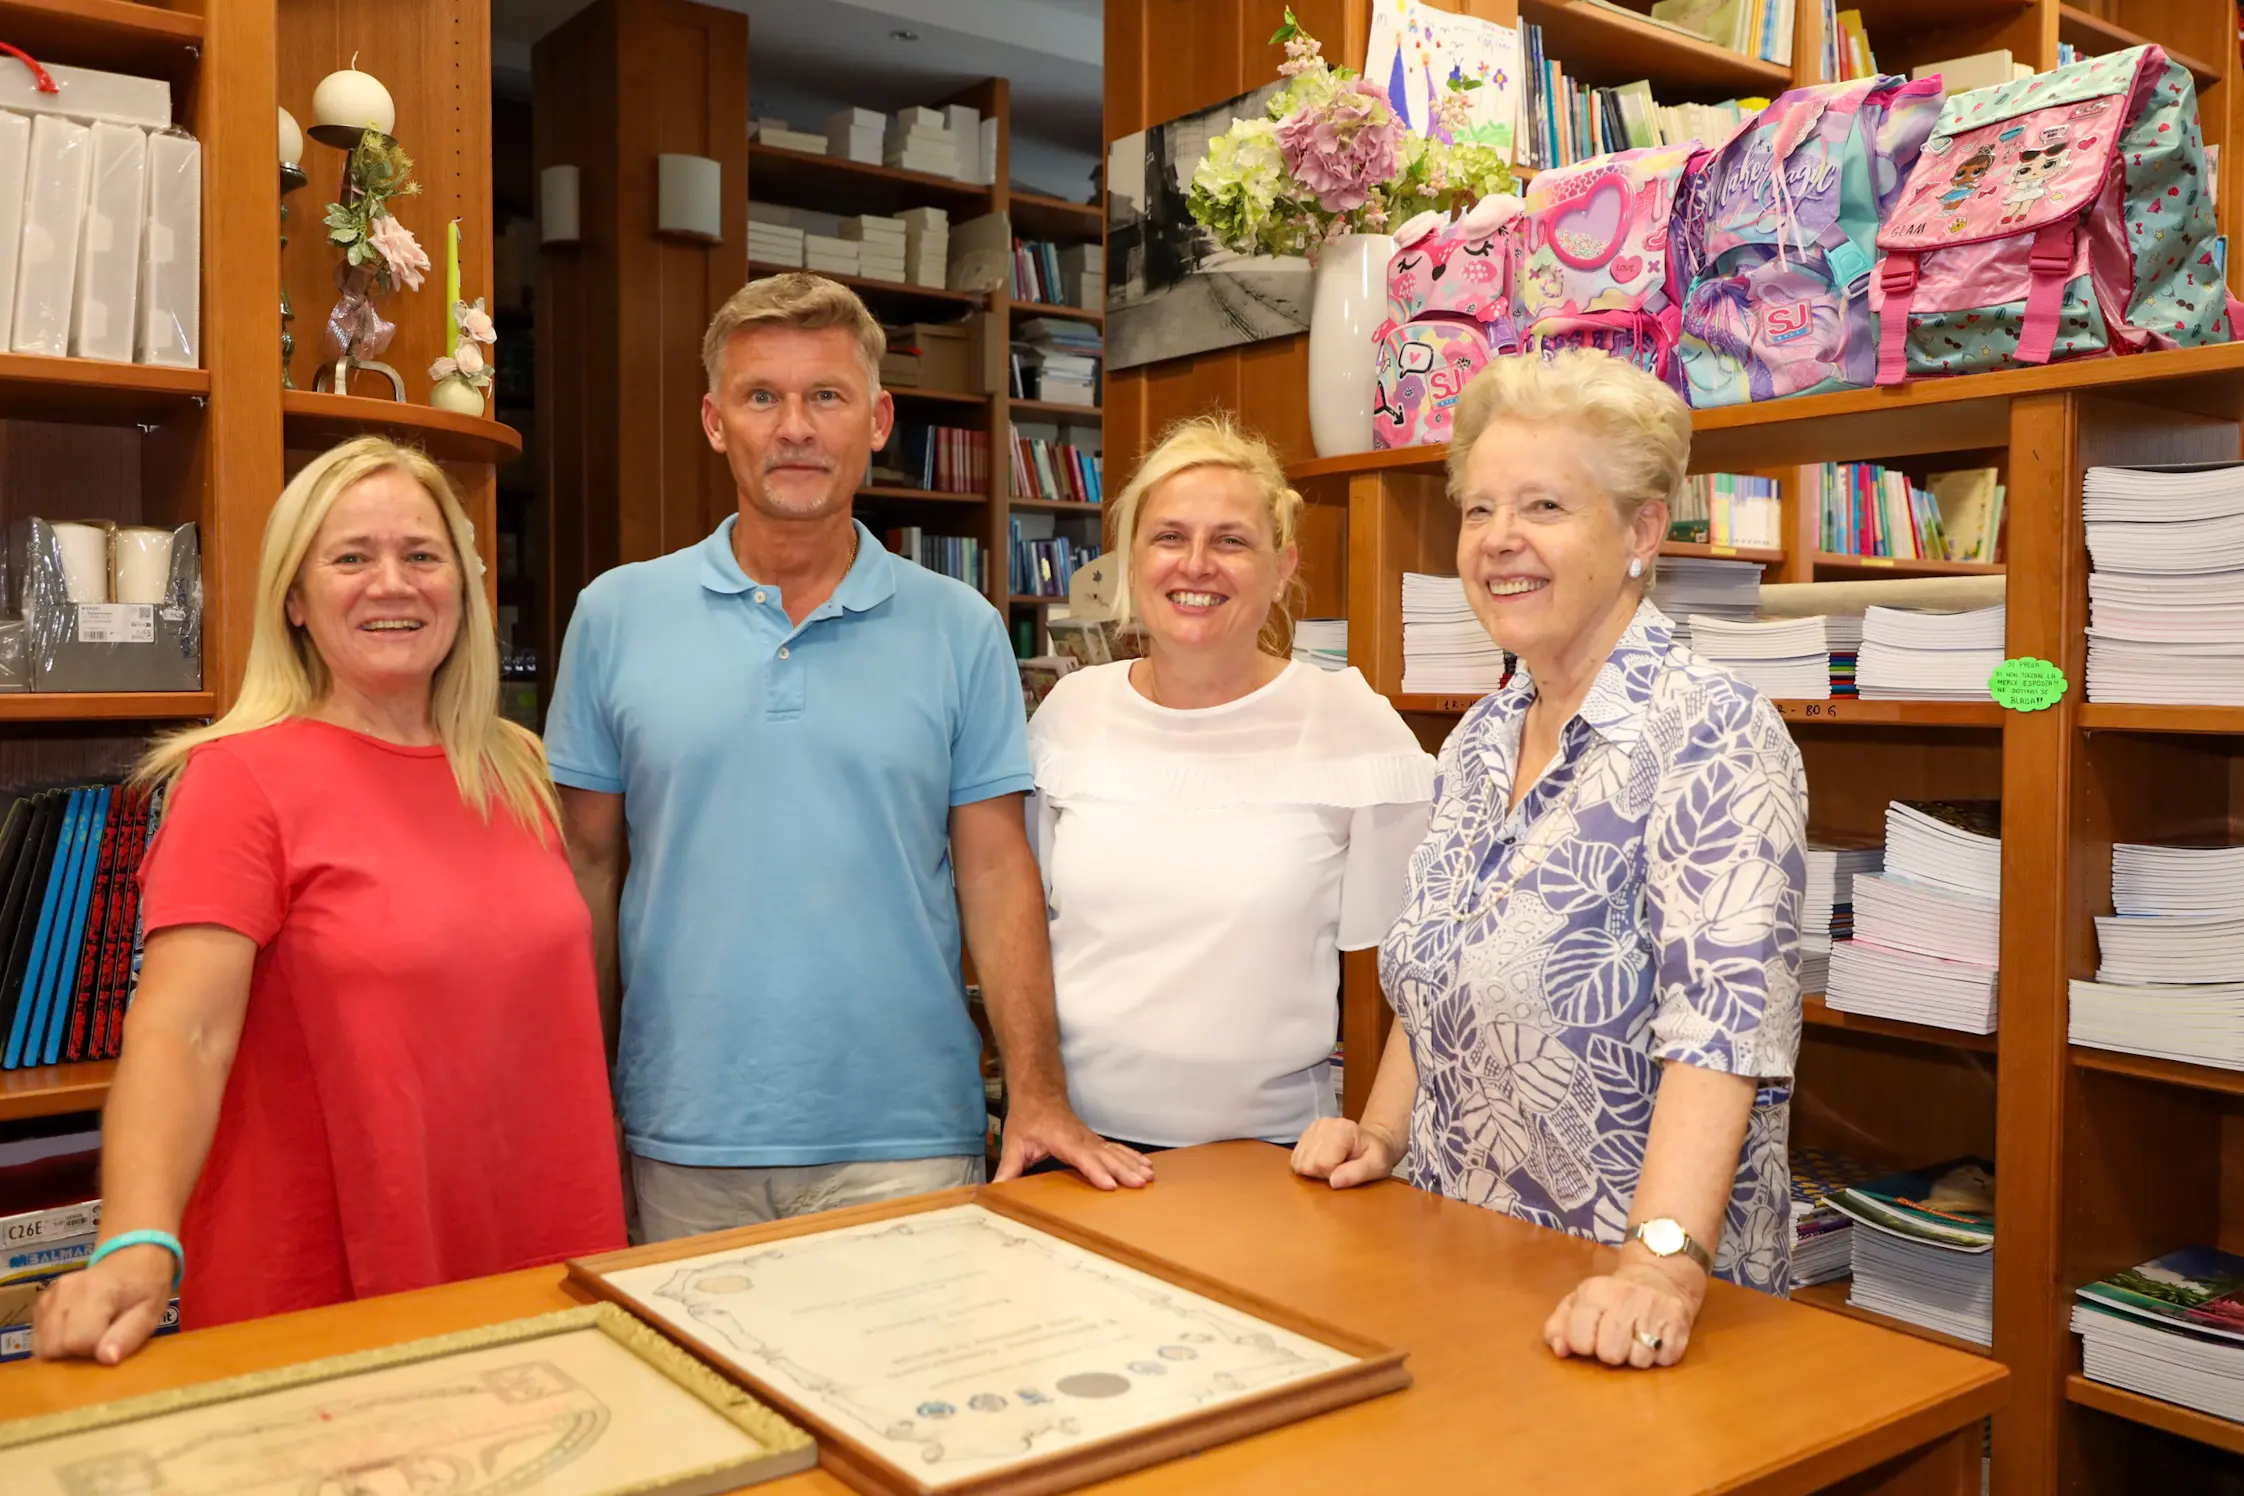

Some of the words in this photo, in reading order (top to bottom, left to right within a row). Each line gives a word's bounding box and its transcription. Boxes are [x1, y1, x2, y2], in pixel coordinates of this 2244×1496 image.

[1891, 222, 1927, 238] GLAM
[1616, 264, 1635, 272] LOVE
[1767, 303, 1807, 335] SJ
[1430, 367, 1463, 400] SJ
[1806, 704, 1820, 717] 80
